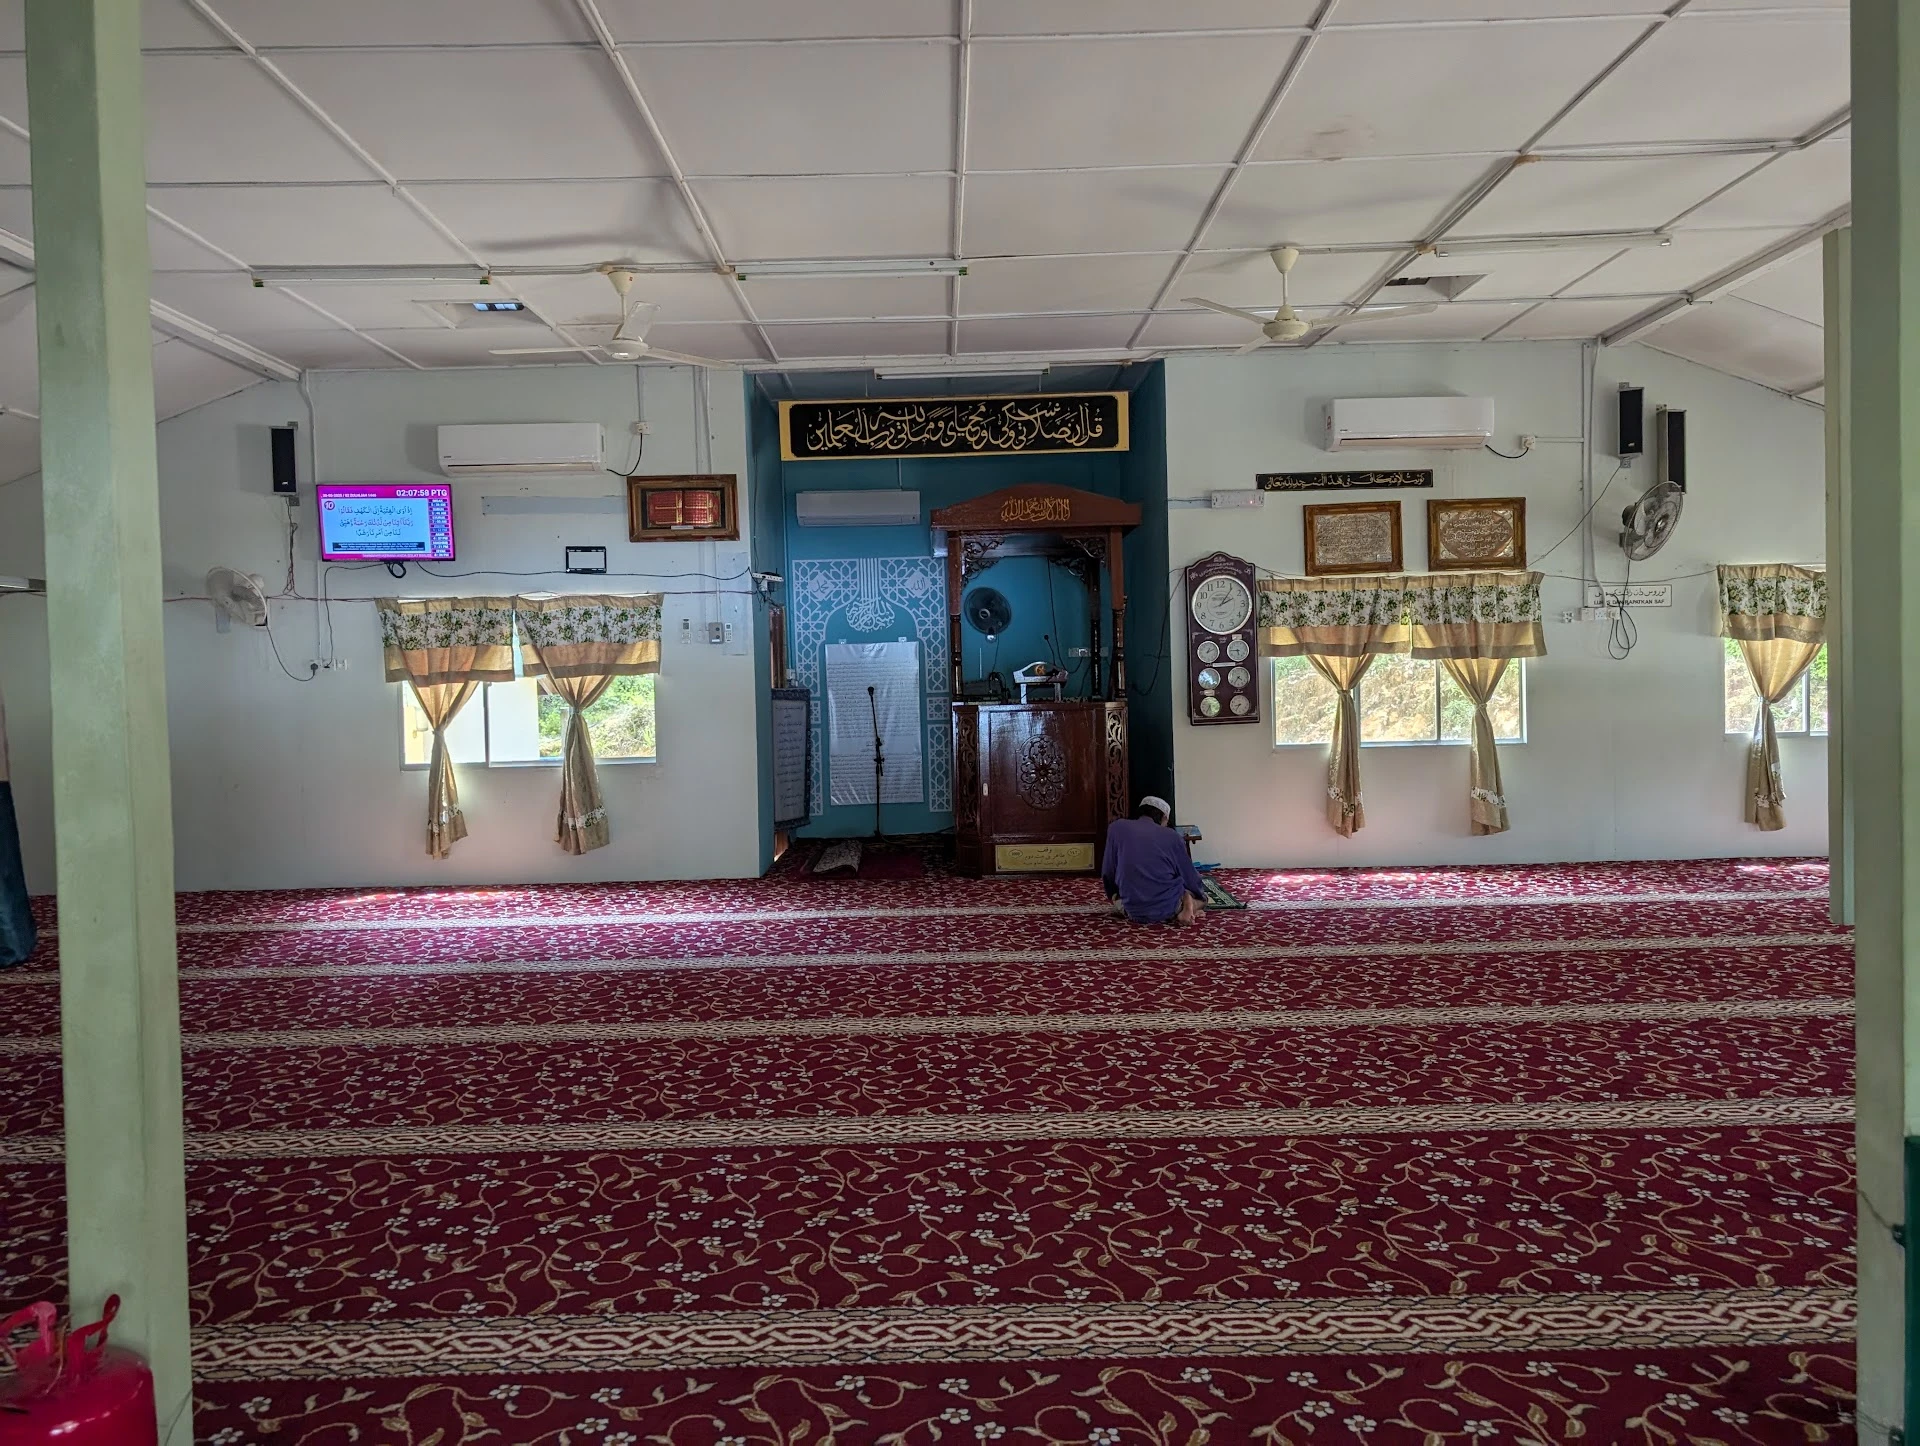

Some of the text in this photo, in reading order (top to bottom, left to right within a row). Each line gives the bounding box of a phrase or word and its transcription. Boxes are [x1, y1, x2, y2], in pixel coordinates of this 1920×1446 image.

[431, 489, 447, 497] PTG
[812, 579, 829, 594] محمد
[910, 577, 925, 591] الله
[1207, 584, 1214, 592] 11
